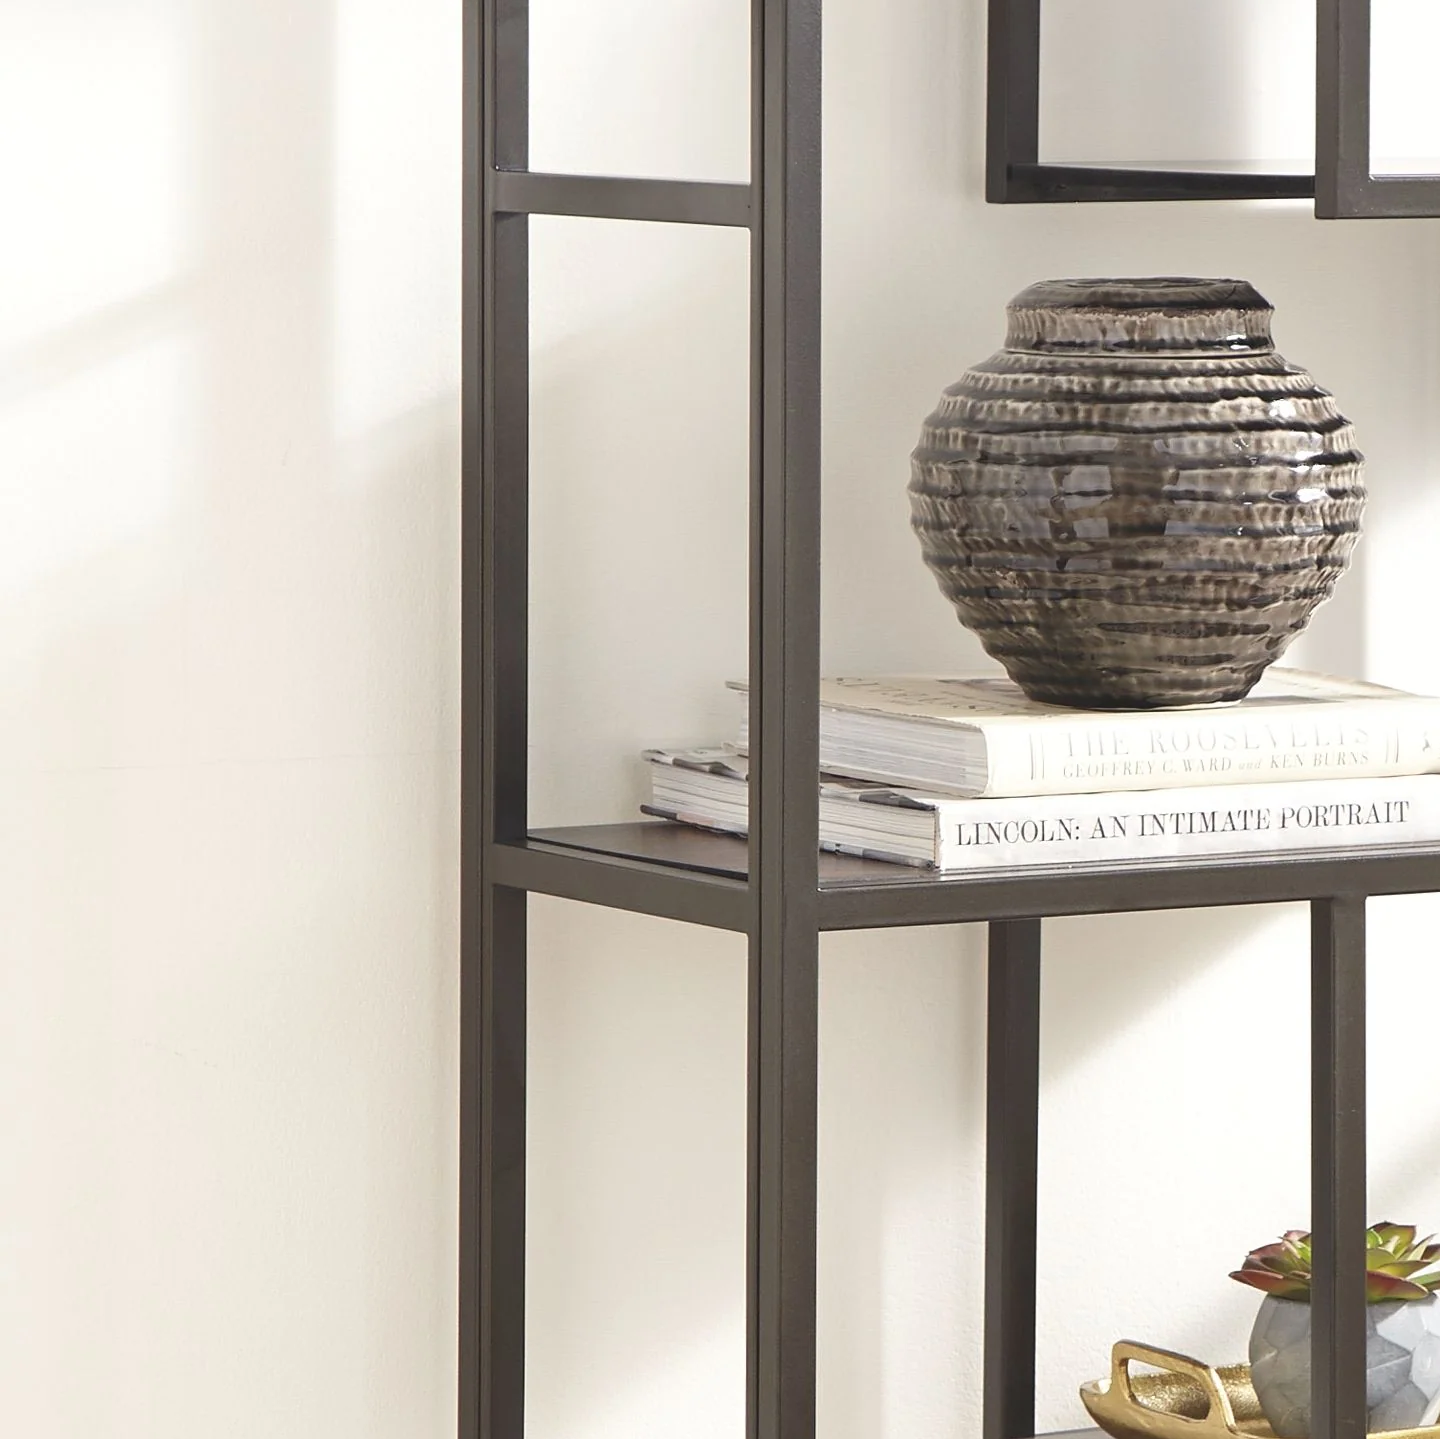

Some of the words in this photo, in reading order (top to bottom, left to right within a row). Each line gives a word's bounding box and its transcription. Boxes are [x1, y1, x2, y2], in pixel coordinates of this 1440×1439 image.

[1062, 730, 1130, 758] THE
[1062, 759, 1153, 779] GEOFFREY
[1162, 758, 1176, 774] C.
[1184, 756, 1233, 773] WARD
[1270, 753, 1305, 770] KEN
[1312, 749, 1370, 768] BURNS
[956, 817, 1081, 847] LINCOLN:
[1088, 814, 1130, 840] AN
[1137, 807, 1271, 837] INTIMATE
[1277, 800, 1410, 830] PORTRAIT
